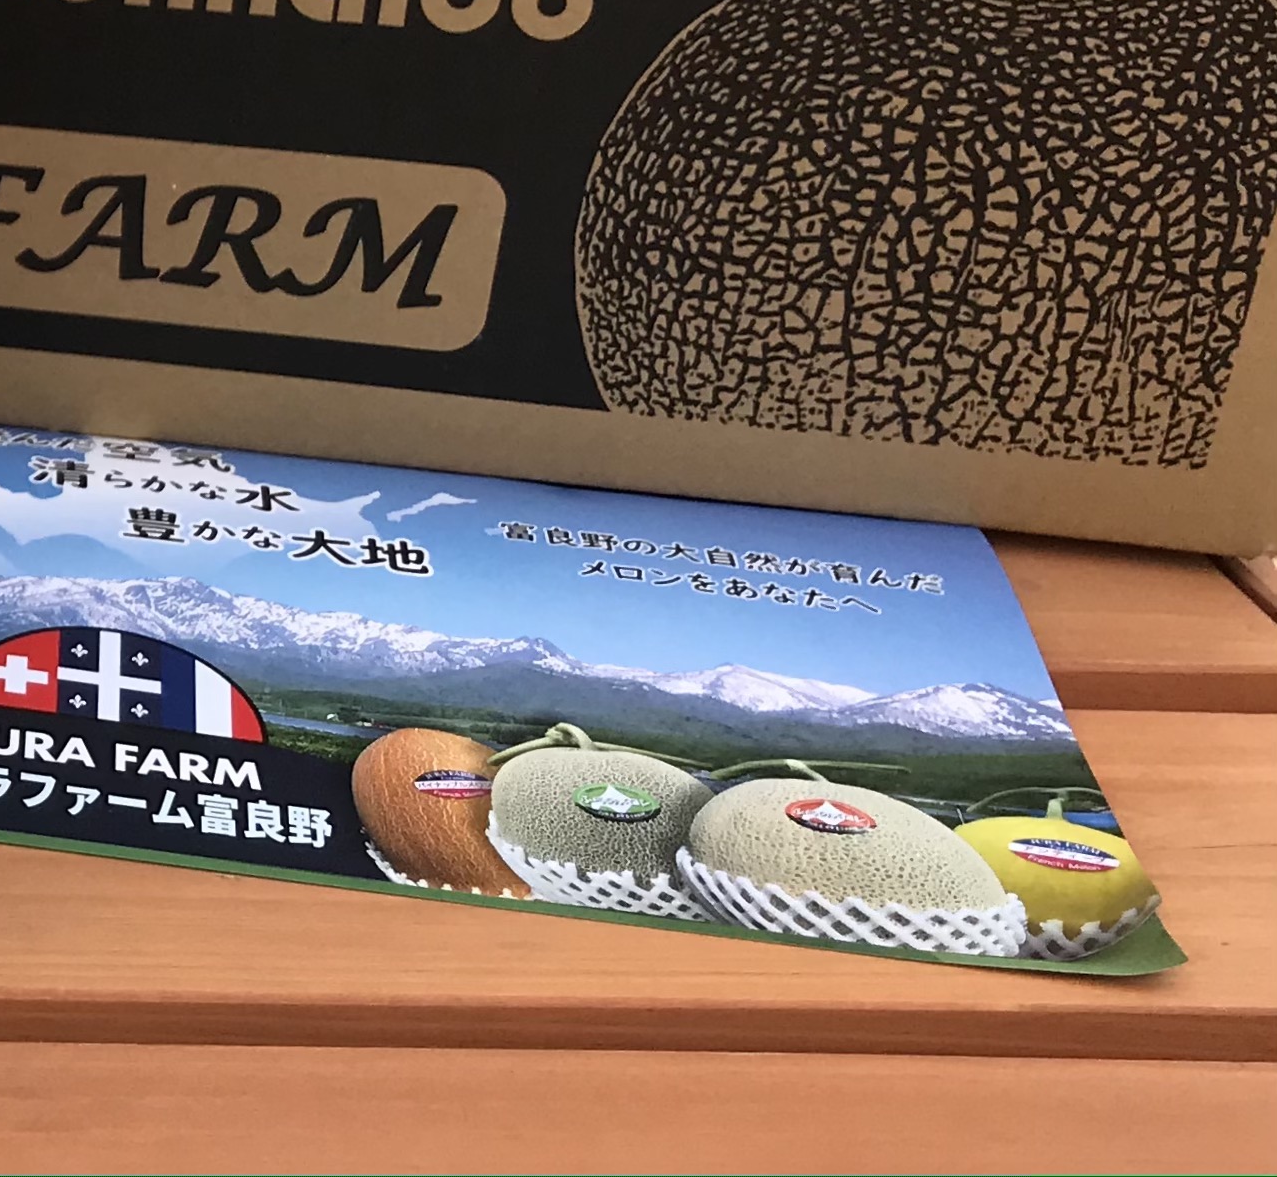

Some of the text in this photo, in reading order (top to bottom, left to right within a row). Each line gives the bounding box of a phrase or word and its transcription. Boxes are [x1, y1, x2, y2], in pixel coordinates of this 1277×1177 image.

[28, 455, 301, 513] 清らかな水
[120, 505, 433, 576] 豊かな大地
[500, 521, 944, 595] 富良野の大自然が育んだ
[580, 560, 883, 615] メロンをあなたへ
[115, 743, 263, 790] FARM
